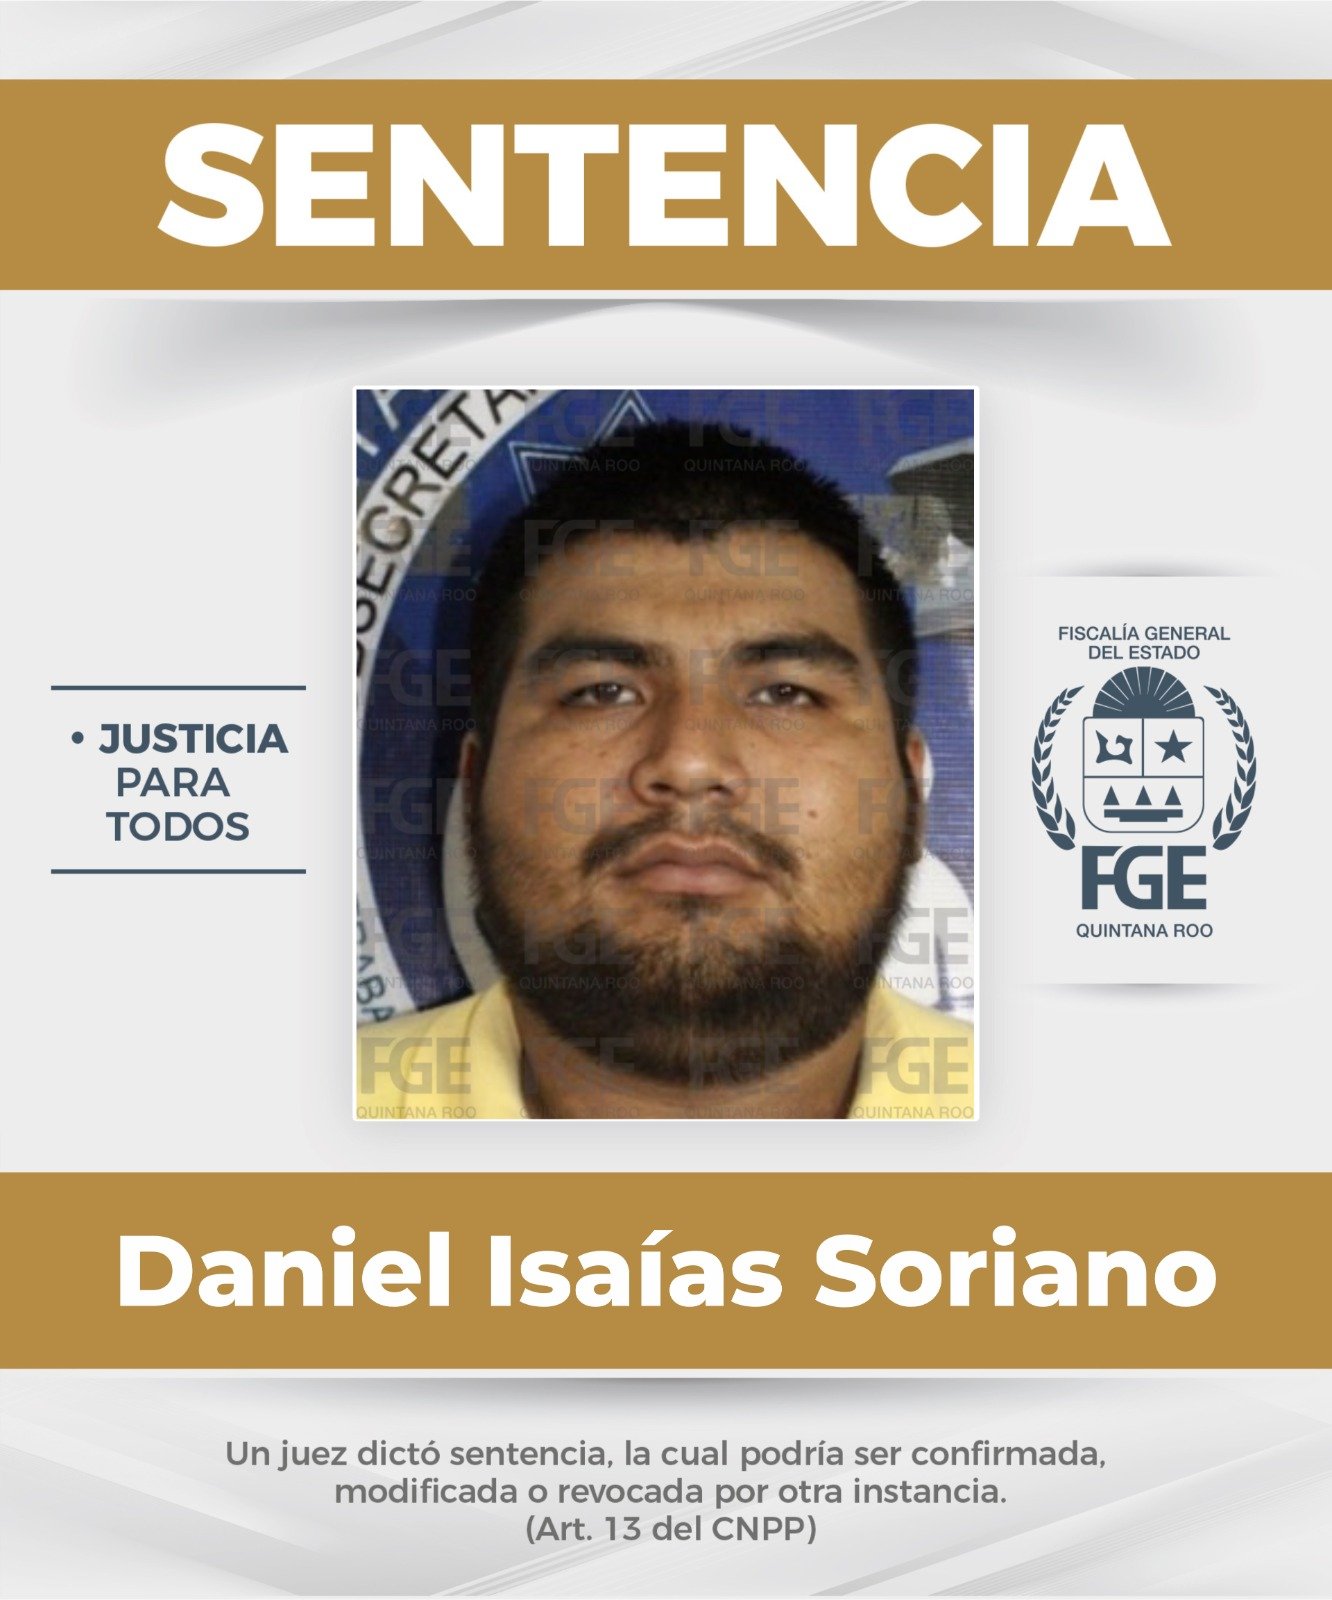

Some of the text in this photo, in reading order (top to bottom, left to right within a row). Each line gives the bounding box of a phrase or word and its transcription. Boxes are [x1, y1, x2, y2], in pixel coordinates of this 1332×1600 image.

[158, 123, 1172, 247] SENTENCIA
[1058, 623, 1231, 641] FISCALÍA GENERAL
[1089, 645, 1201, 660] DEL ESTADO
[98, 722, 290, 755] JUSTICIA
[117, 767, 231, 797] PARA
[105, 811, 250, 842] TODOS
[1081, 845, 1207, 910] FGE
[1076, 923, 1214, 939] QUINTANA ROO
[120, 1226, 1216, 1307] Daniel Isaías Soriano
[227, 1440, 1105, 1471] Un juez dictó sentencia, la cual podría ser confirmada,
[336, 1478, 1006, 1509] modificada o revocada por otra instancia.
[527, 1515, 816, 1544] (Art. 13 del CNPP)
